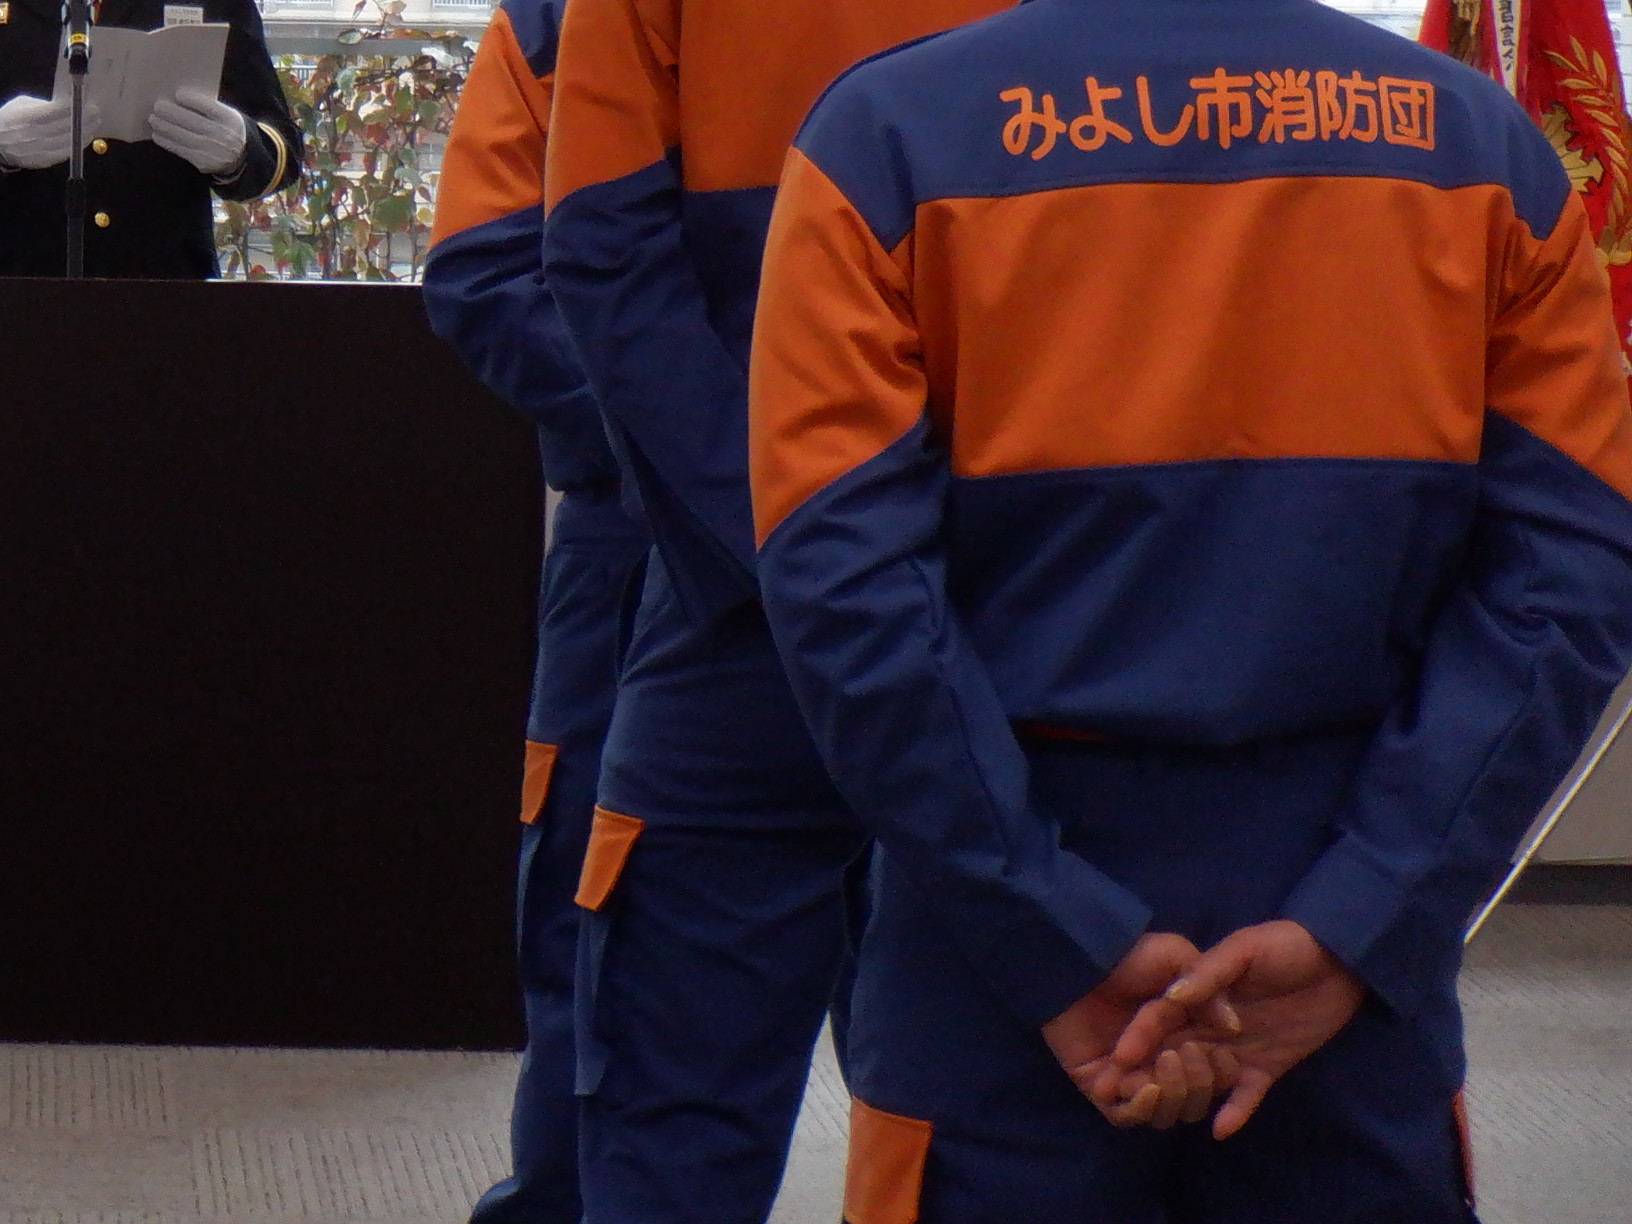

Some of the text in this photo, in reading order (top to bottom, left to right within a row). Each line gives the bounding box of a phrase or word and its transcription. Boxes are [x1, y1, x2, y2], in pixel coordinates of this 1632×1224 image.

[999, 67, 1436, 161] みよし市消防団
